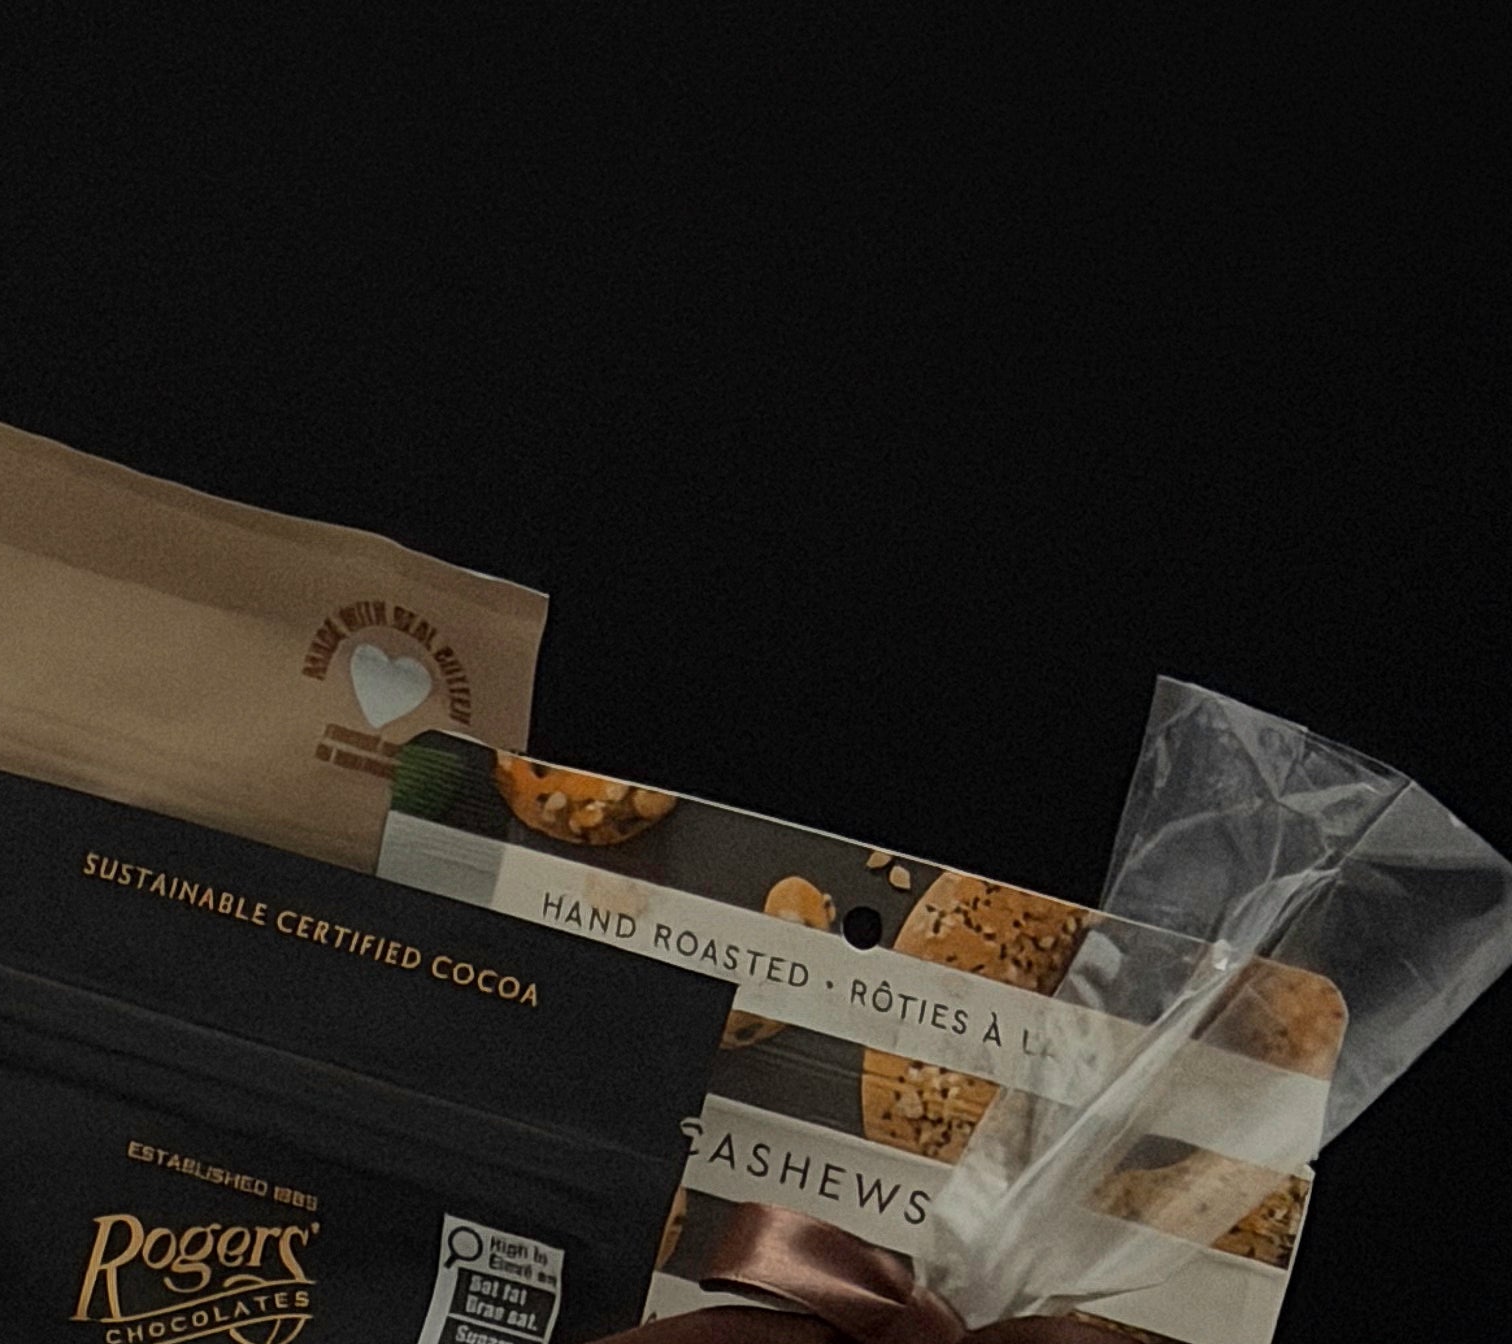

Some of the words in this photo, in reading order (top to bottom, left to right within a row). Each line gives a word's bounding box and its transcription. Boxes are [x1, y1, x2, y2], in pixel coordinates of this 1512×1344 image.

[82, 851, 267, 926] SUSTAINABLE
[275, 910, 423, 970] CERTIFIED
[431, 955, 539, 1007] COCOA
[542, 892, 637, 941] HAND
[653, 923, 810, 989] ROASTED
[851, 978, 970, 1036] RÔTIES
[983, 1012, 1002, 1047] À
[127, 1140, 268, 1197] ESTABLISHED
